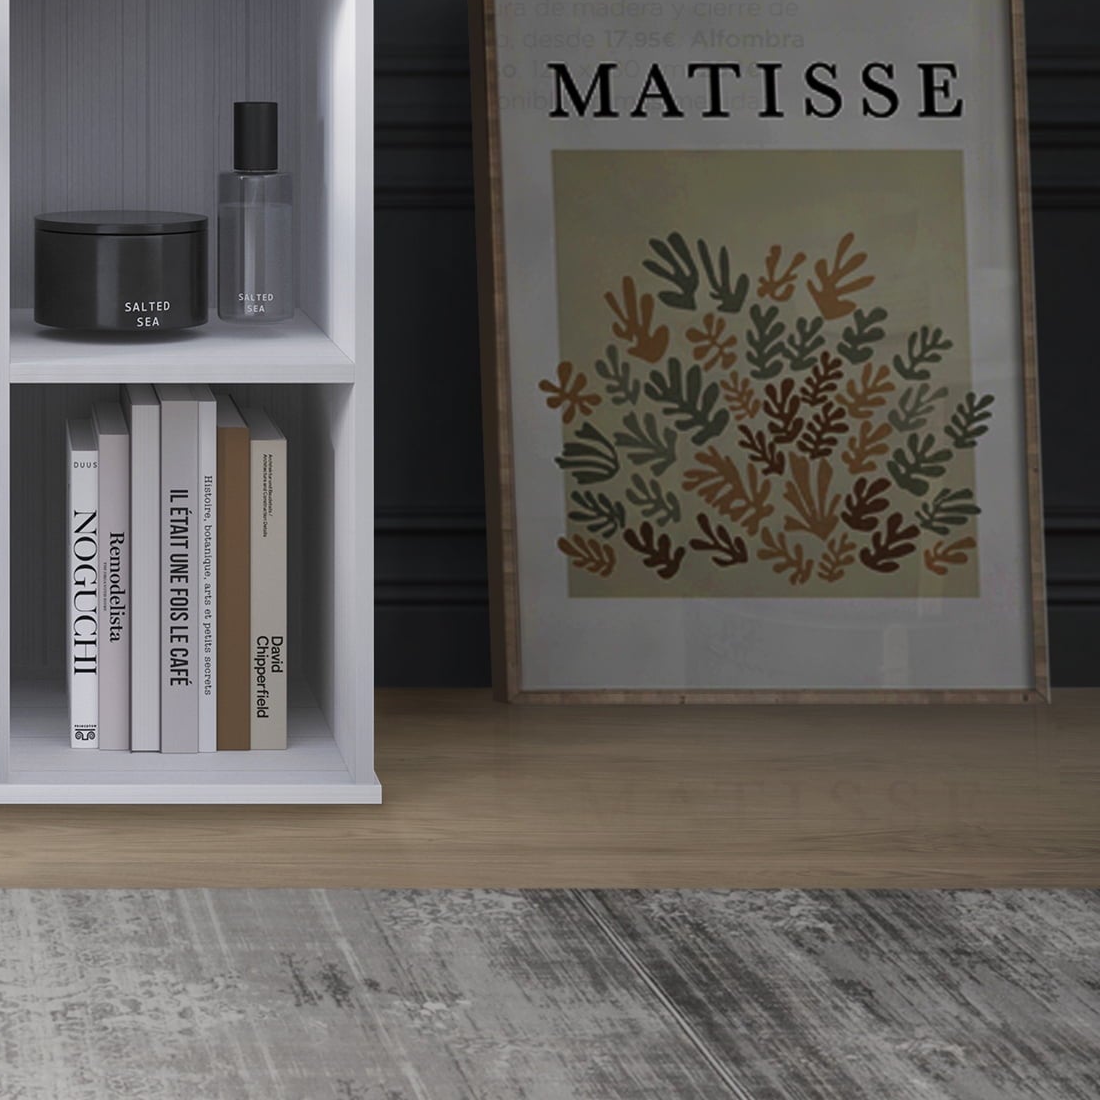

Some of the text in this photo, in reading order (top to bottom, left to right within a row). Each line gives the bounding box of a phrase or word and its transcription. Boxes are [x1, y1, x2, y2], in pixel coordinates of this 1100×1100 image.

[523, 28, 596, 49] desde
[691, 27, 806, 49] Alfombra
[547, 62, 964, 119] MATISSE
[124, 301, 171, 313] SALTED
[238, 293, 274, 302] SALTED
[247, 304, 265, 313] SEA
[136, 317, 160, 328] SEA
[73, 461, 98, 469] DUUS
[73, 509, 98, 676] NOGUCHI
[109, 531, 126, 643] Remodelista
[170, 489, 193, 686] IL ÉTAIT UNE FOIS LE CAFÉ
[202, 475, 213, 696] Histoire, botanique, arts et petits secrets
[270, 636, 283, 673] David
[256, 635, 269, 719] Chipperfield
